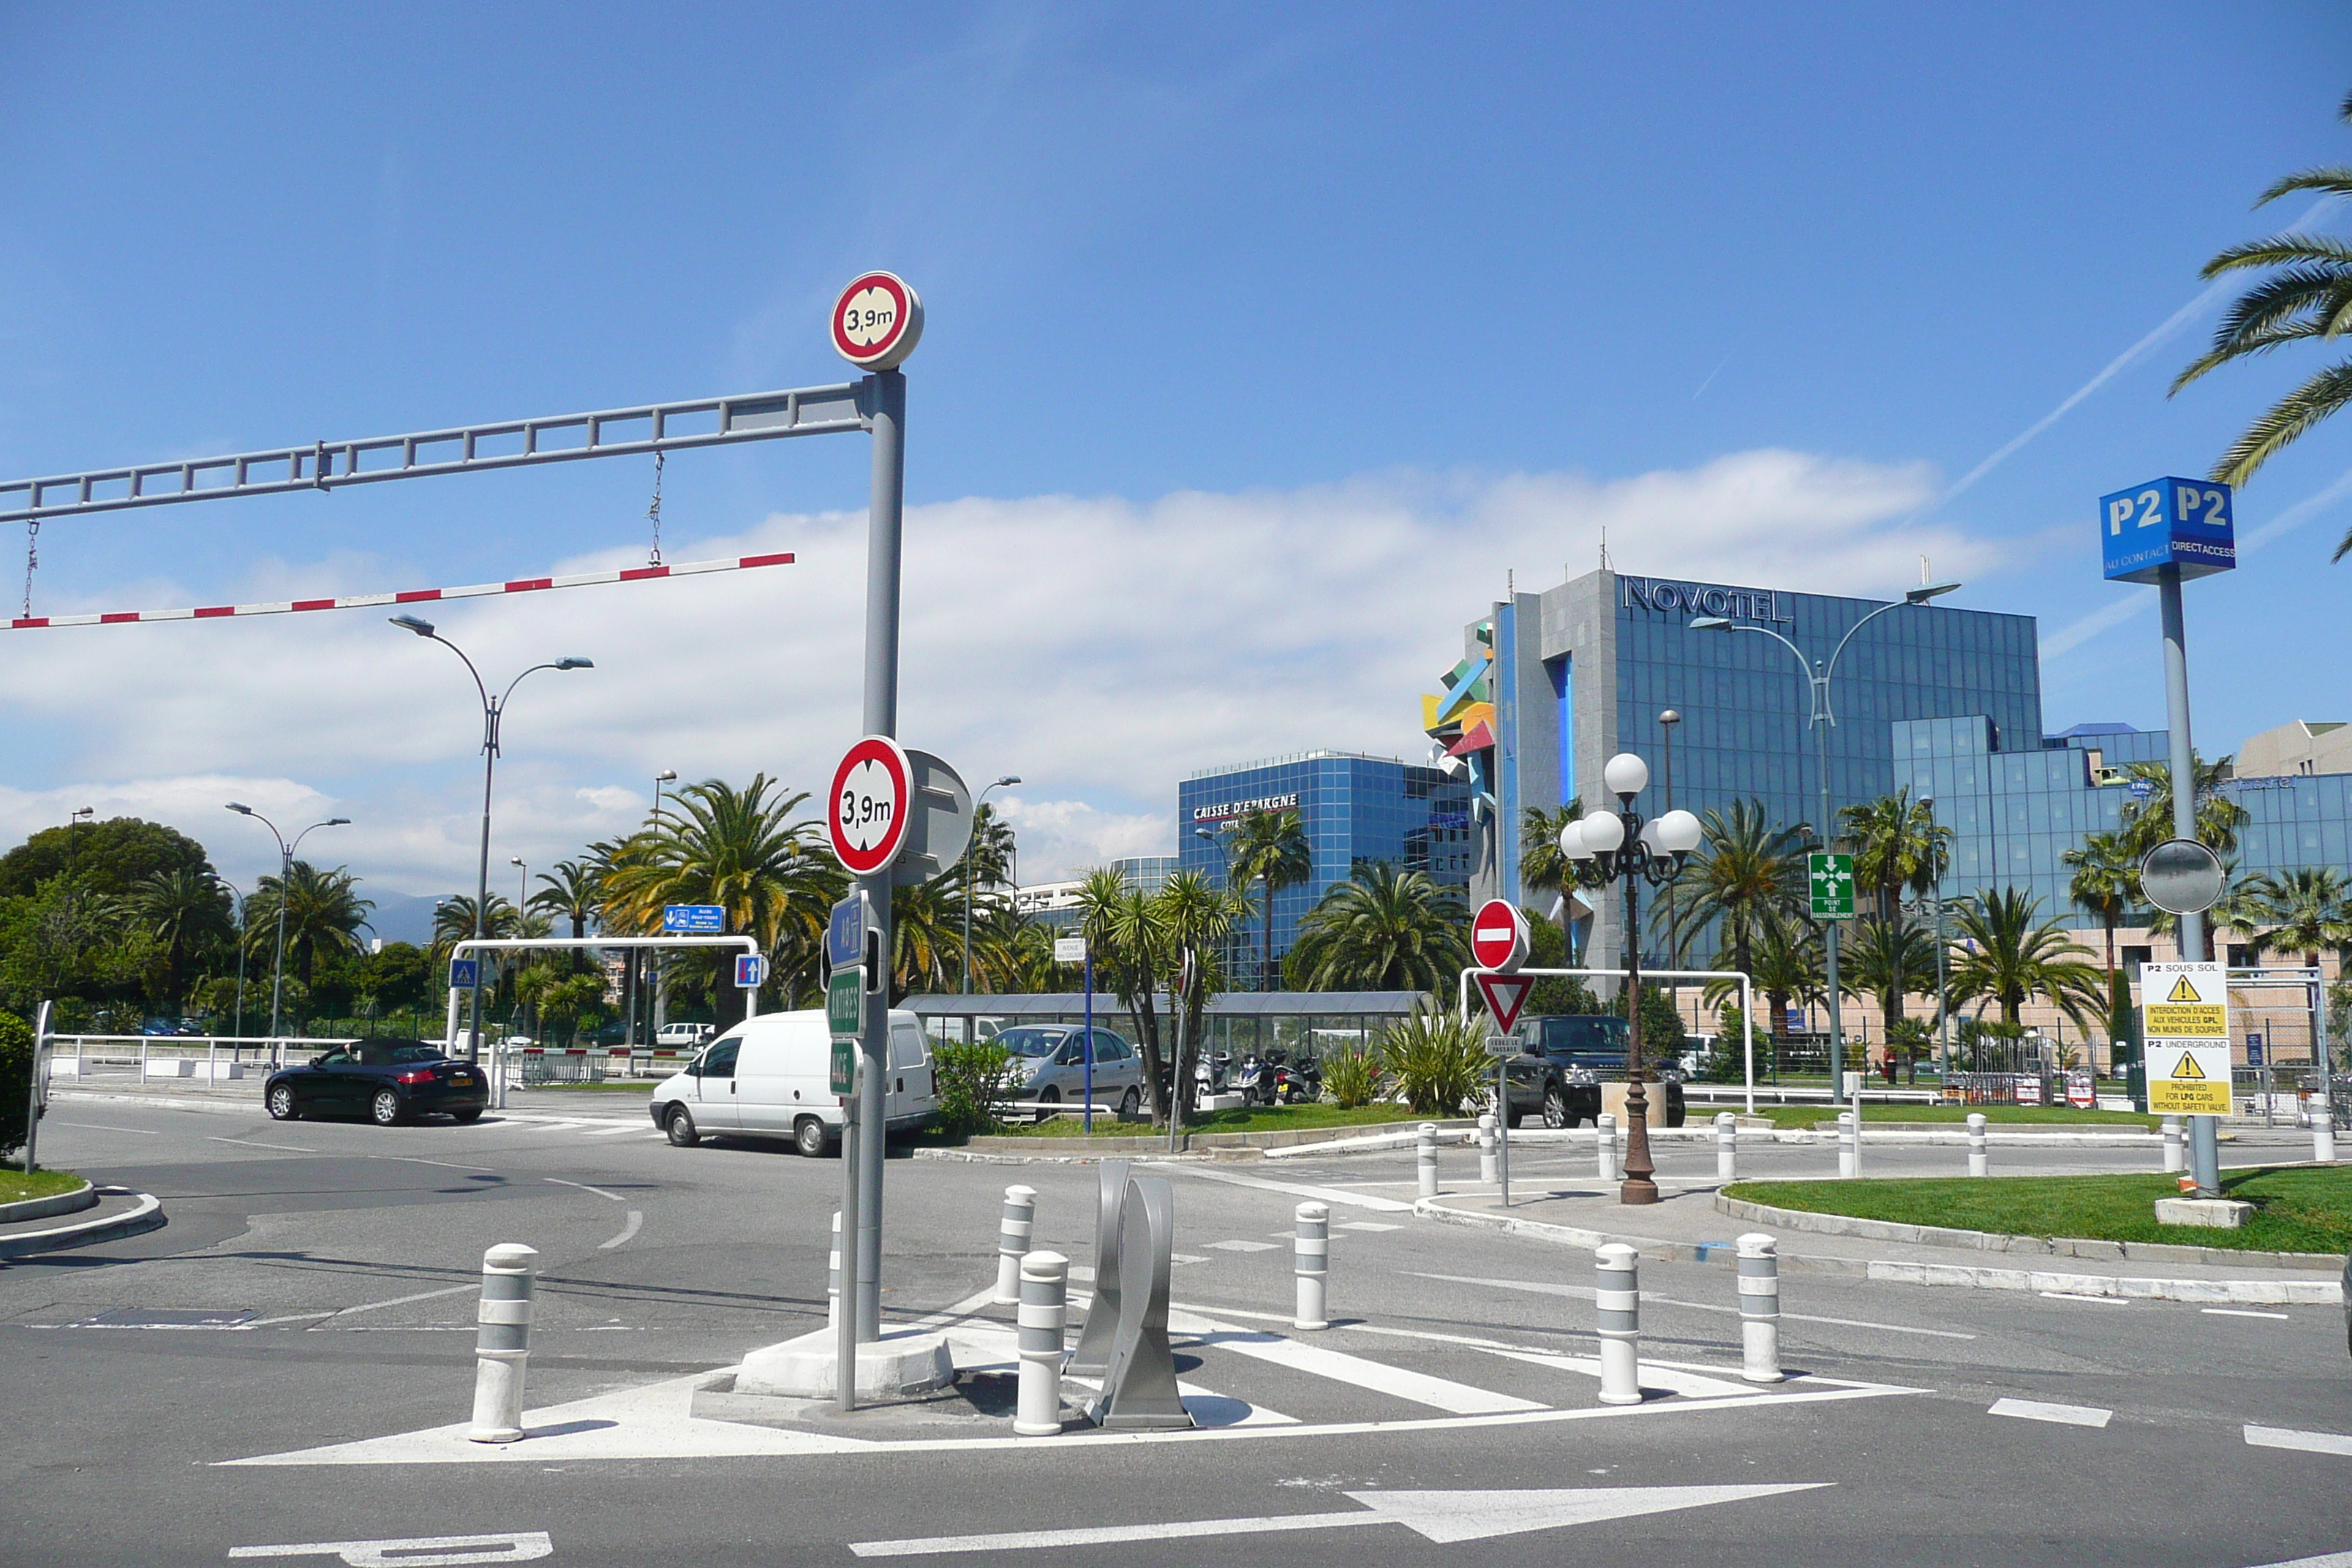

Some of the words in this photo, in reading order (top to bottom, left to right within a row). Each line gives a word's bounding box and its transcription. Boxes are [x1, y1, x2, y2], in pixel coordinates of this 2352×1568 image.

[847, 309, 892, 331] 3,9m
[2109, 489, 2162, 536] P2
[2177, 486, 2226, 526] P2
[2121, 545, 2169, 566] CONTACT
[1622, 576, 1794, 622] NOVOTEL
[841, 791, 891, 829] 3,9m
[1194, 804, 1229, 819] CAISSE
[1234, 794, 1297, 813] D'EPARGNE
[2198, 964, 2218, 972] SOL
[832, 987, 857, 1019] ANTIBES
[832, 1053, 847, 1083] NICE
[2171, 1083, 2207, 1091] PROHIBITED
[2196, 1093, 2214, 1101] CARS
